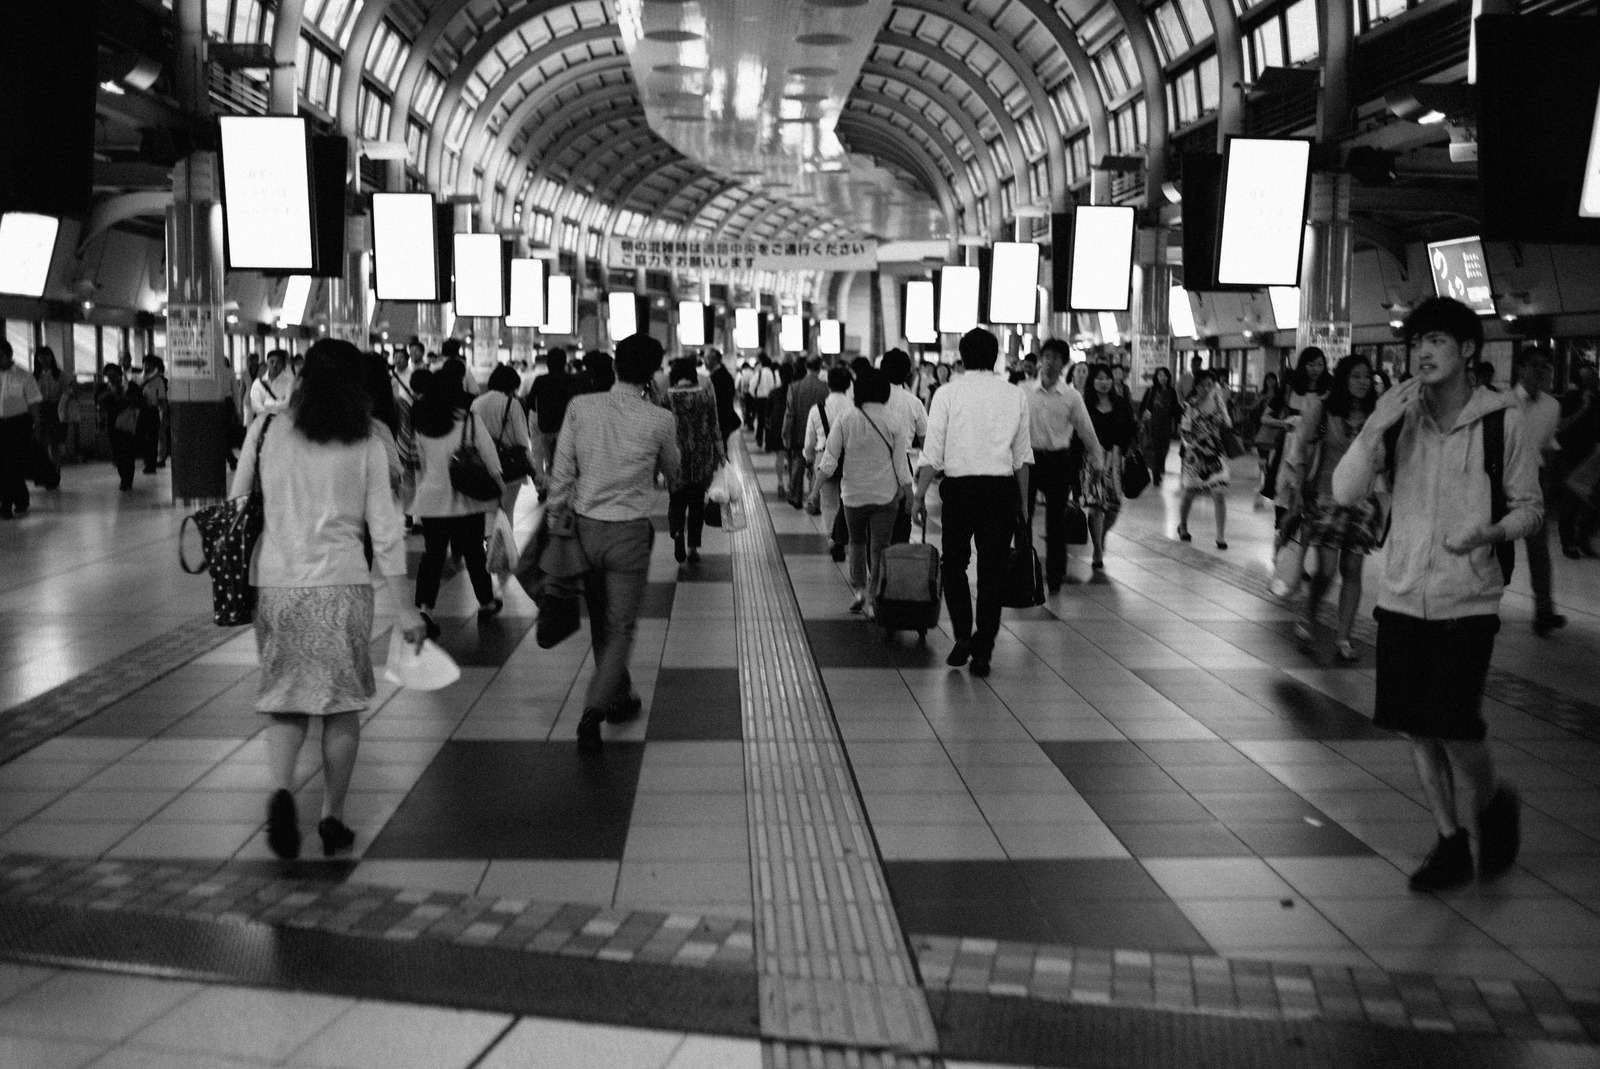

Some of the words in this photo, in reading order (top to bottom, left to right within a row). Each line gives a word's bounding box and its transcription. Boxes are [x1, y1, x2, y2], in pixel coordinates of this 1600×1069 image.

[621, 254, 755, 269] ご協力をお願いします
